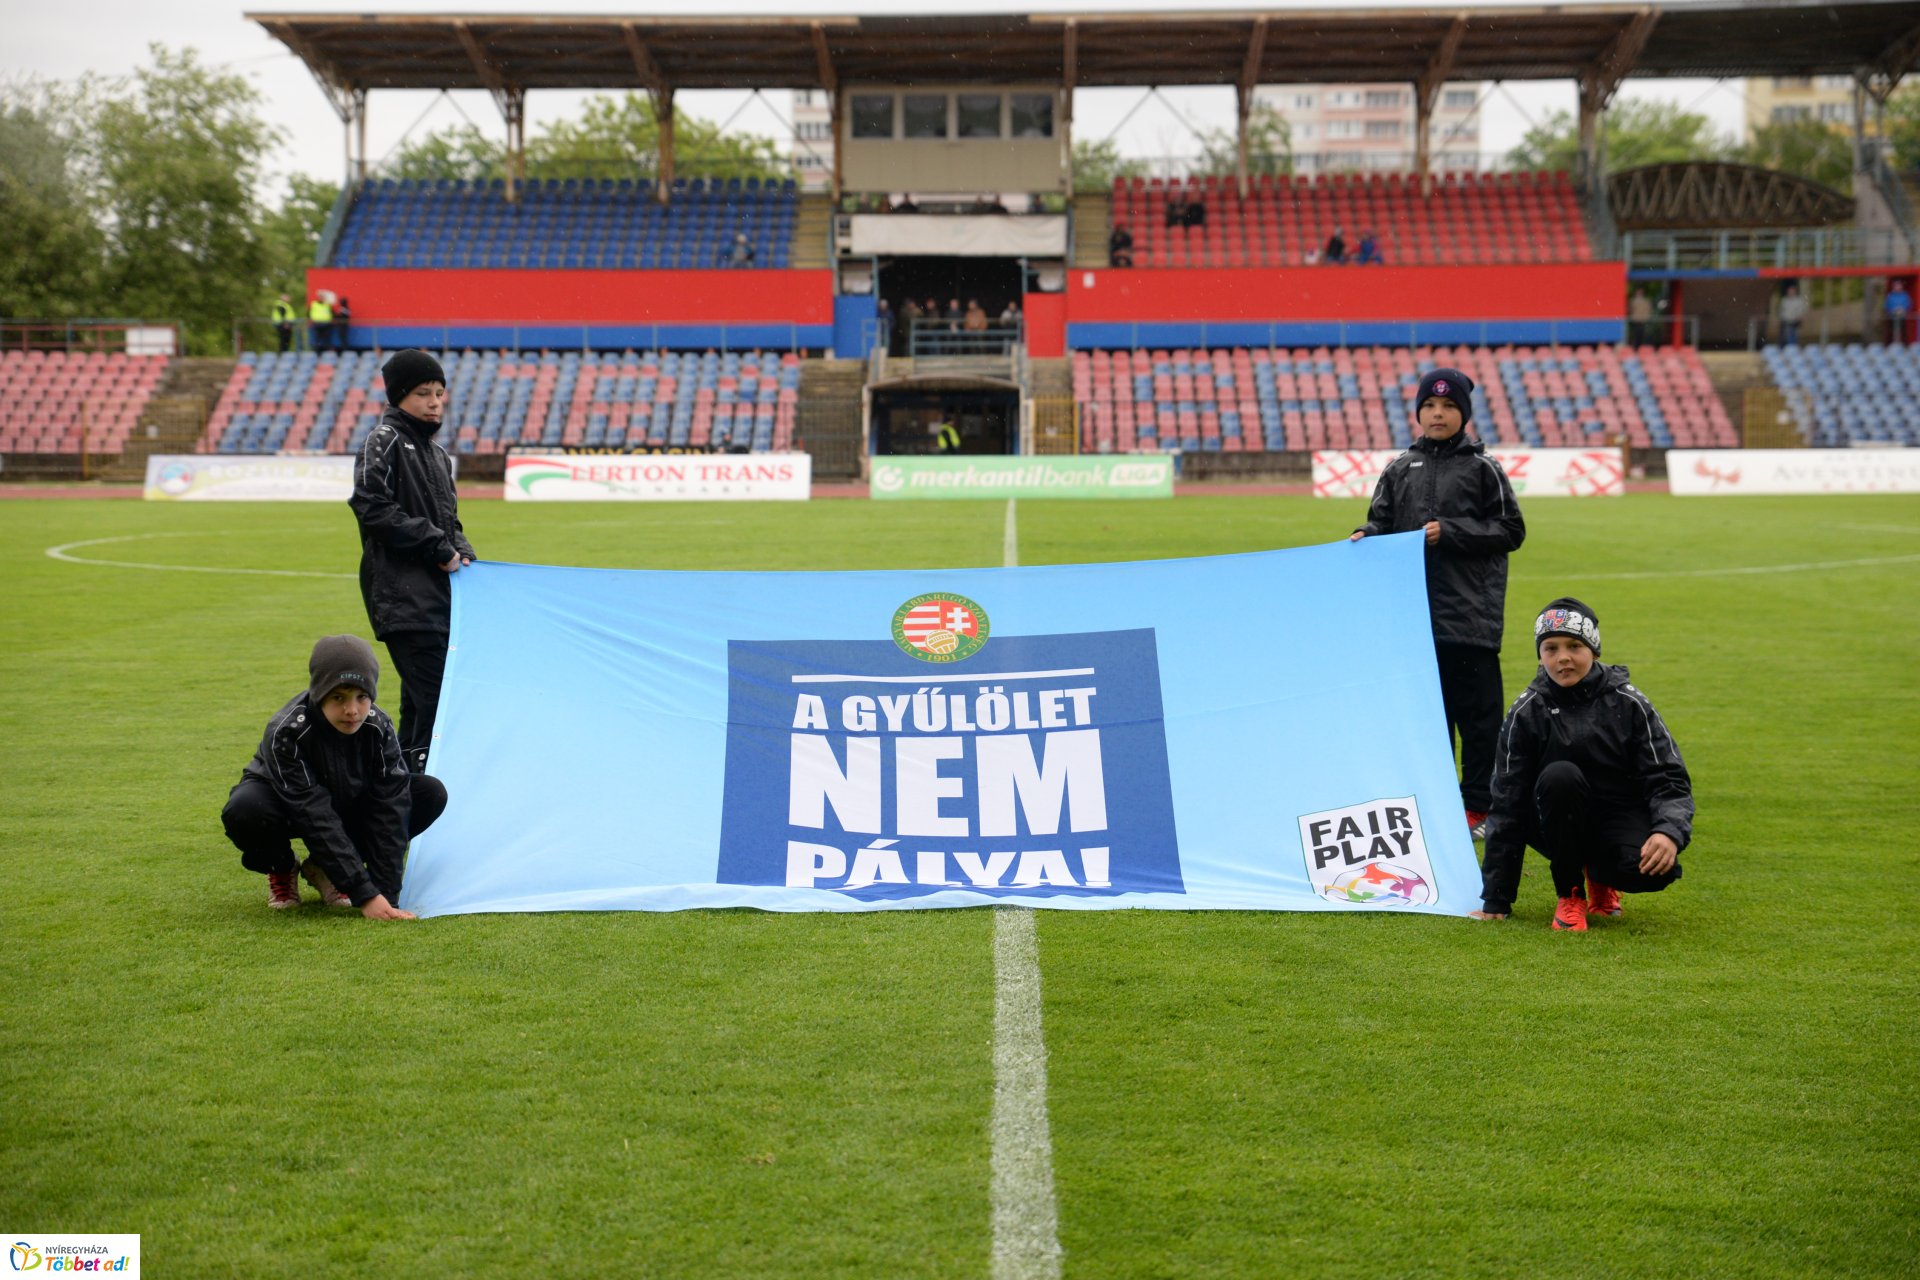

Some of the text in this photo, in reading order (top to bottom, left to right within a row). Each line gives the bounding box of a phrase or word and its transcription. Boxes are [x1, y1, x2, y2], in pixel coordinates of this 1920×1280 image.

[695, 464, 793, 481] TRANS
[927, 653, 957, 662] 1901
[792, 686, 1097, 732] A GYŰLÖLET
[788, 728, 1108, 838] NEM
[1309, 807, 1412, 847] FAIR
[786, 839, 1112, 889] PÁLYA!
[1314, 830, 1413, 870] PLAY
